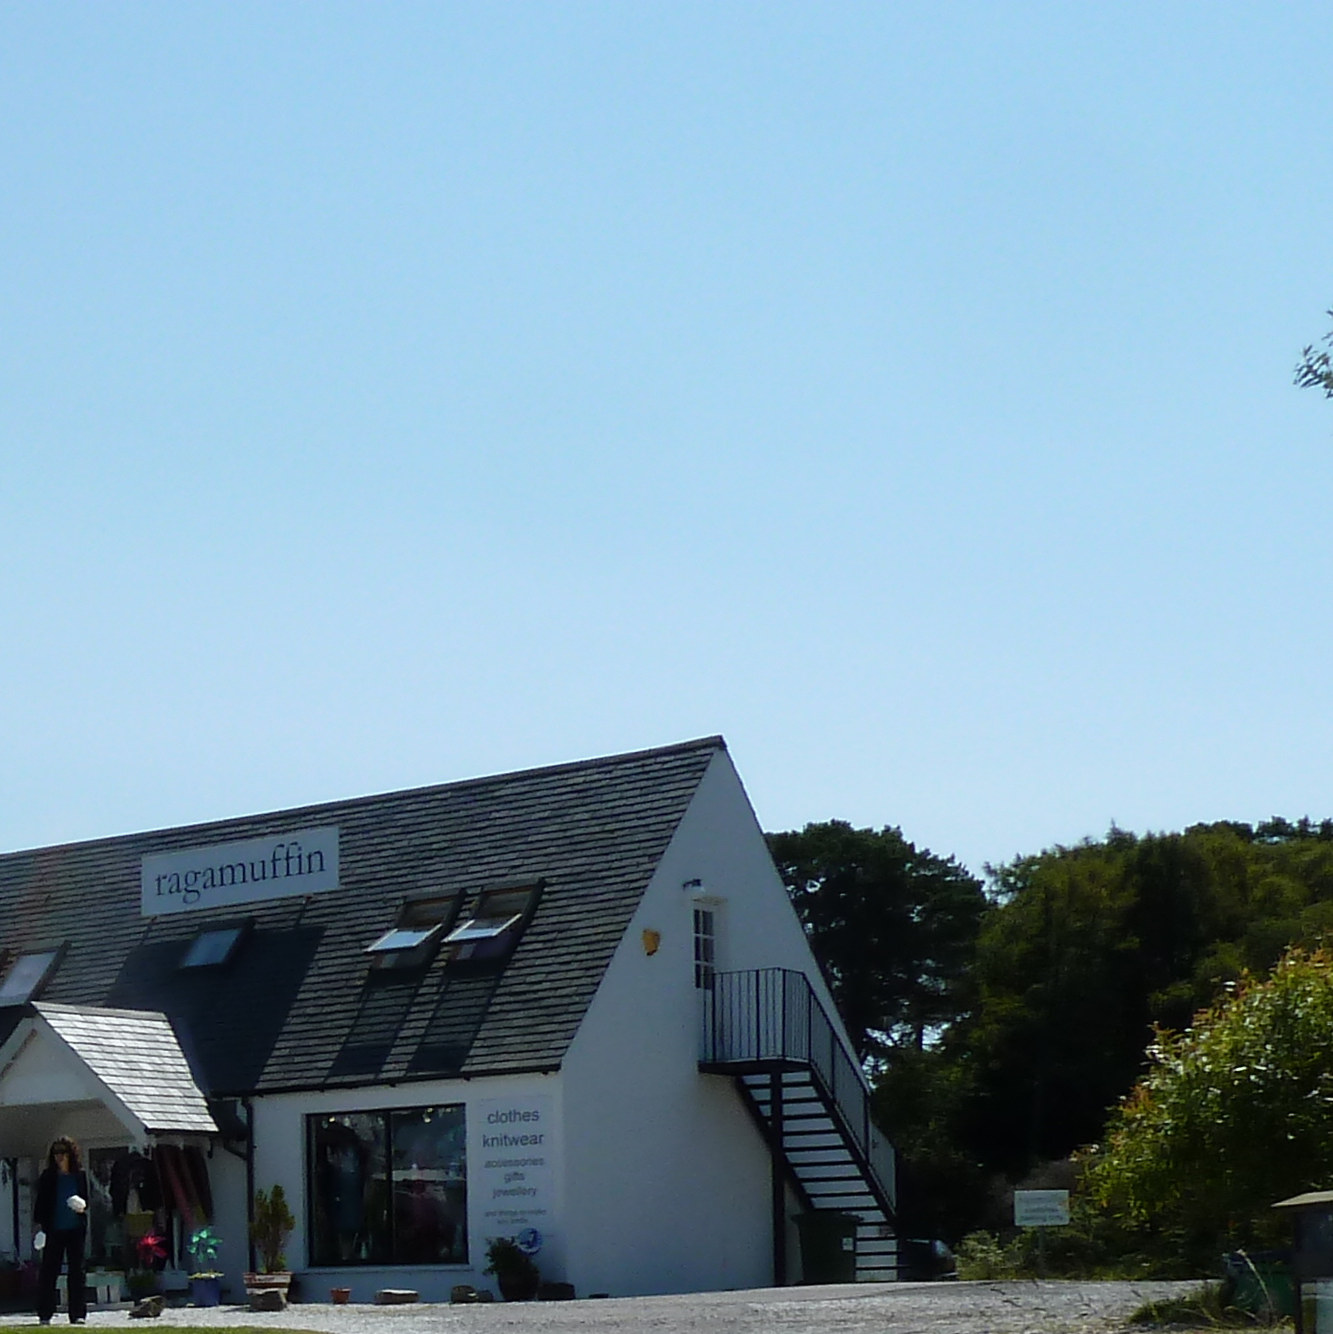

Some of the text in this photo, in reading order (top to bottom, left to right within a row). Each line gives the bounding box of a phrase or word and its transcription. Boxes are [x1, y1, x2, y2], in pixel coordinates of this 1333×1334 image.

[154, 841, 326, 904] ragamuffin
[487, 1109, 540, 1125] clothes
[482, 1132, 545, 1149] knitwear
